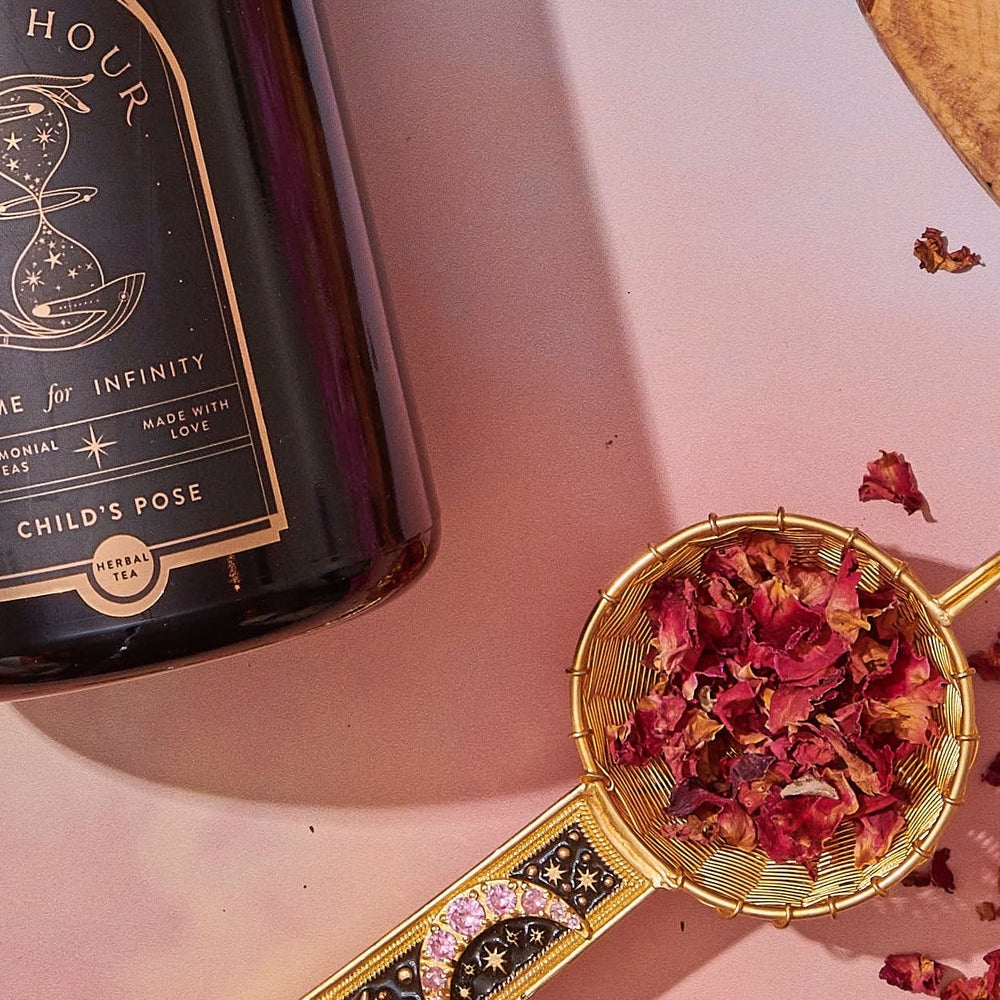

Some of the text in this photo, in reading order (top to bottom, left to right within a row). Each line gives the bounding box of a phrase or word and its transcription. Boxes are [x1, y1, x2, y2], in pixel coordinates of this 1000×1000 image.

[26, 8, 150, 127] HOUR
[43, 383, 73, 413] for
[93, 353, 205, 395] INFINITY
[142, 399, 230, 430] MADE WITH
[170, 420, 210, 440] LOVE
[134, 483, 202, 515] POSE
[96, 553, 150, 572] HERBAL
[112, 570, 138, 582] TEA
